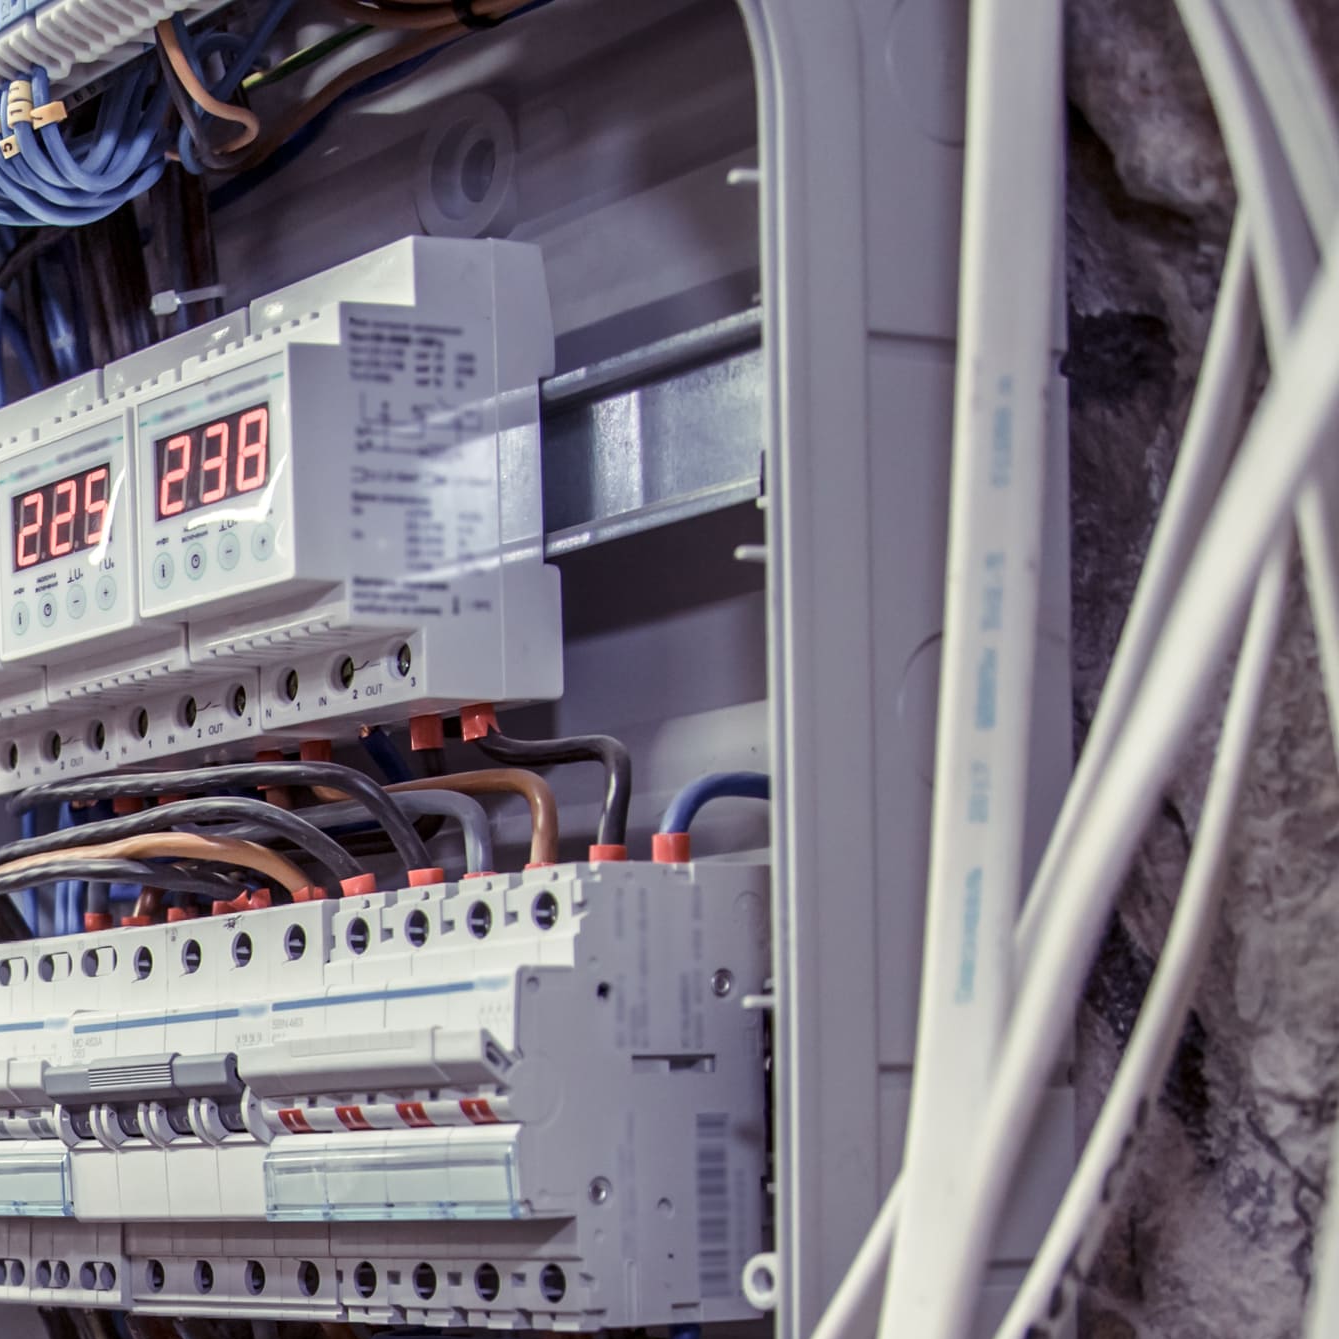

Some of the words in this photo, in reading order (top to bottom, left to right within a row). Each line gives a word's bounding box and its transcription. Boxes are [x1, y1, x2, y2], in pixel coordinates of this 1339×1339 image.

[160, 408, 269, 516] 238
[17, 468, 109, 568] 225
[353, 690, 358, 699] 2
[365, 684, 383, 697] OUT
[411, 677, 416, 687] 3
[208, 723, 223, 735] OUT
